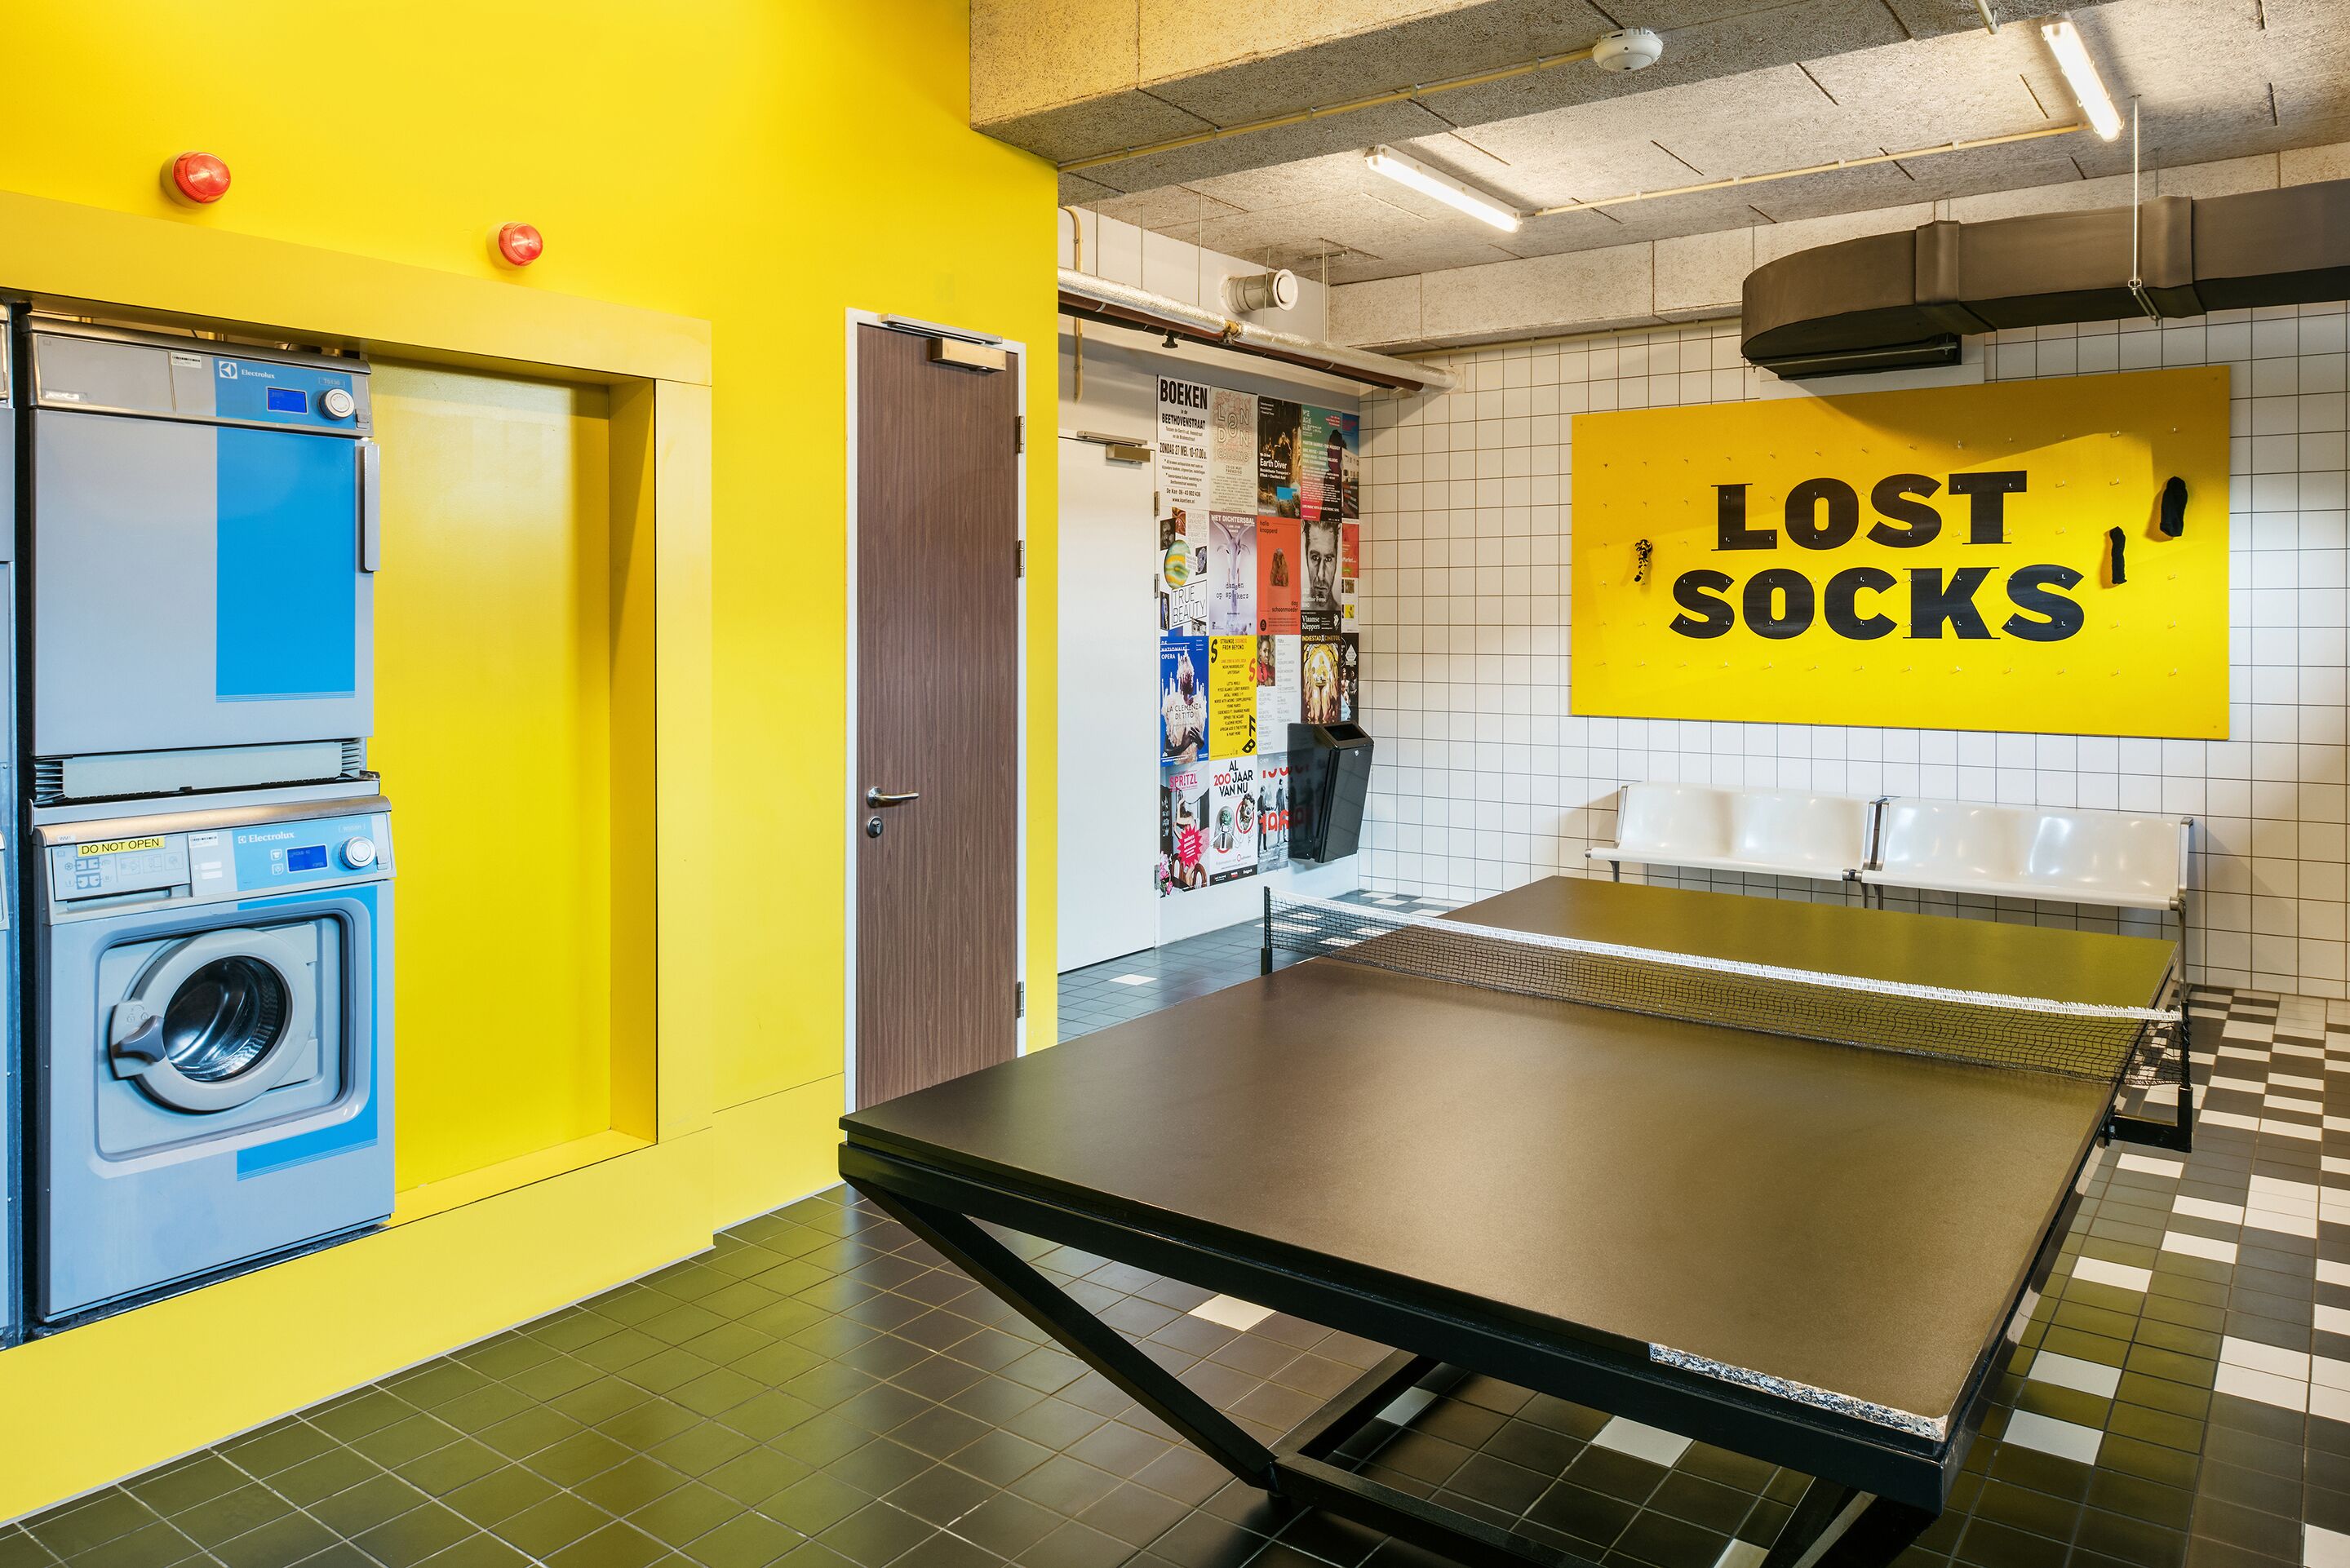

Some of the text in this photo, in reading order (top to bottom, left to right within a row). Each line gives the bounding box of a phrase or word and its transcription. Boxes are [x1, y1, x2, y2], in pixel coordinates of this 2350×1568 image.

[242, 369, 276, 380] Electrolux
[1160, 379, 1208, 410] BOEKEN
[1162, 413, 1205, 430] BEETHOVENSTRAAT
[1159, 442, 1174, 454] ZONDAG
[1175, 445, 1180, 455] 27
[1217, 448, 1249, 463] CALLING
[1260, 458, 1288, 470] Earth Diver
[1711, 470, 2028, 551] LOST
[1222, 516, 1255, 525] DICHTERSBAL
[1173, 586, 1195, 606] TRUE
[1669, 564, 2085, 643] SOCKS
[1173, 599, 1205, 623] BEAUTY
[1301, 622, 1320, 631] Kleppers
[1175, 702, 1202, 712] CLEMENZA
[1229, 760, 1239, 772] AL
[1214, 773, 1230, 786] 200
[1232, 769, 1253, 783] JAAR
[1219, 782, 1248, 797] VAN NU
[249, 831, 295, 843] Electrolux
[82, 838, 160, 855] DO NOT OPEN
